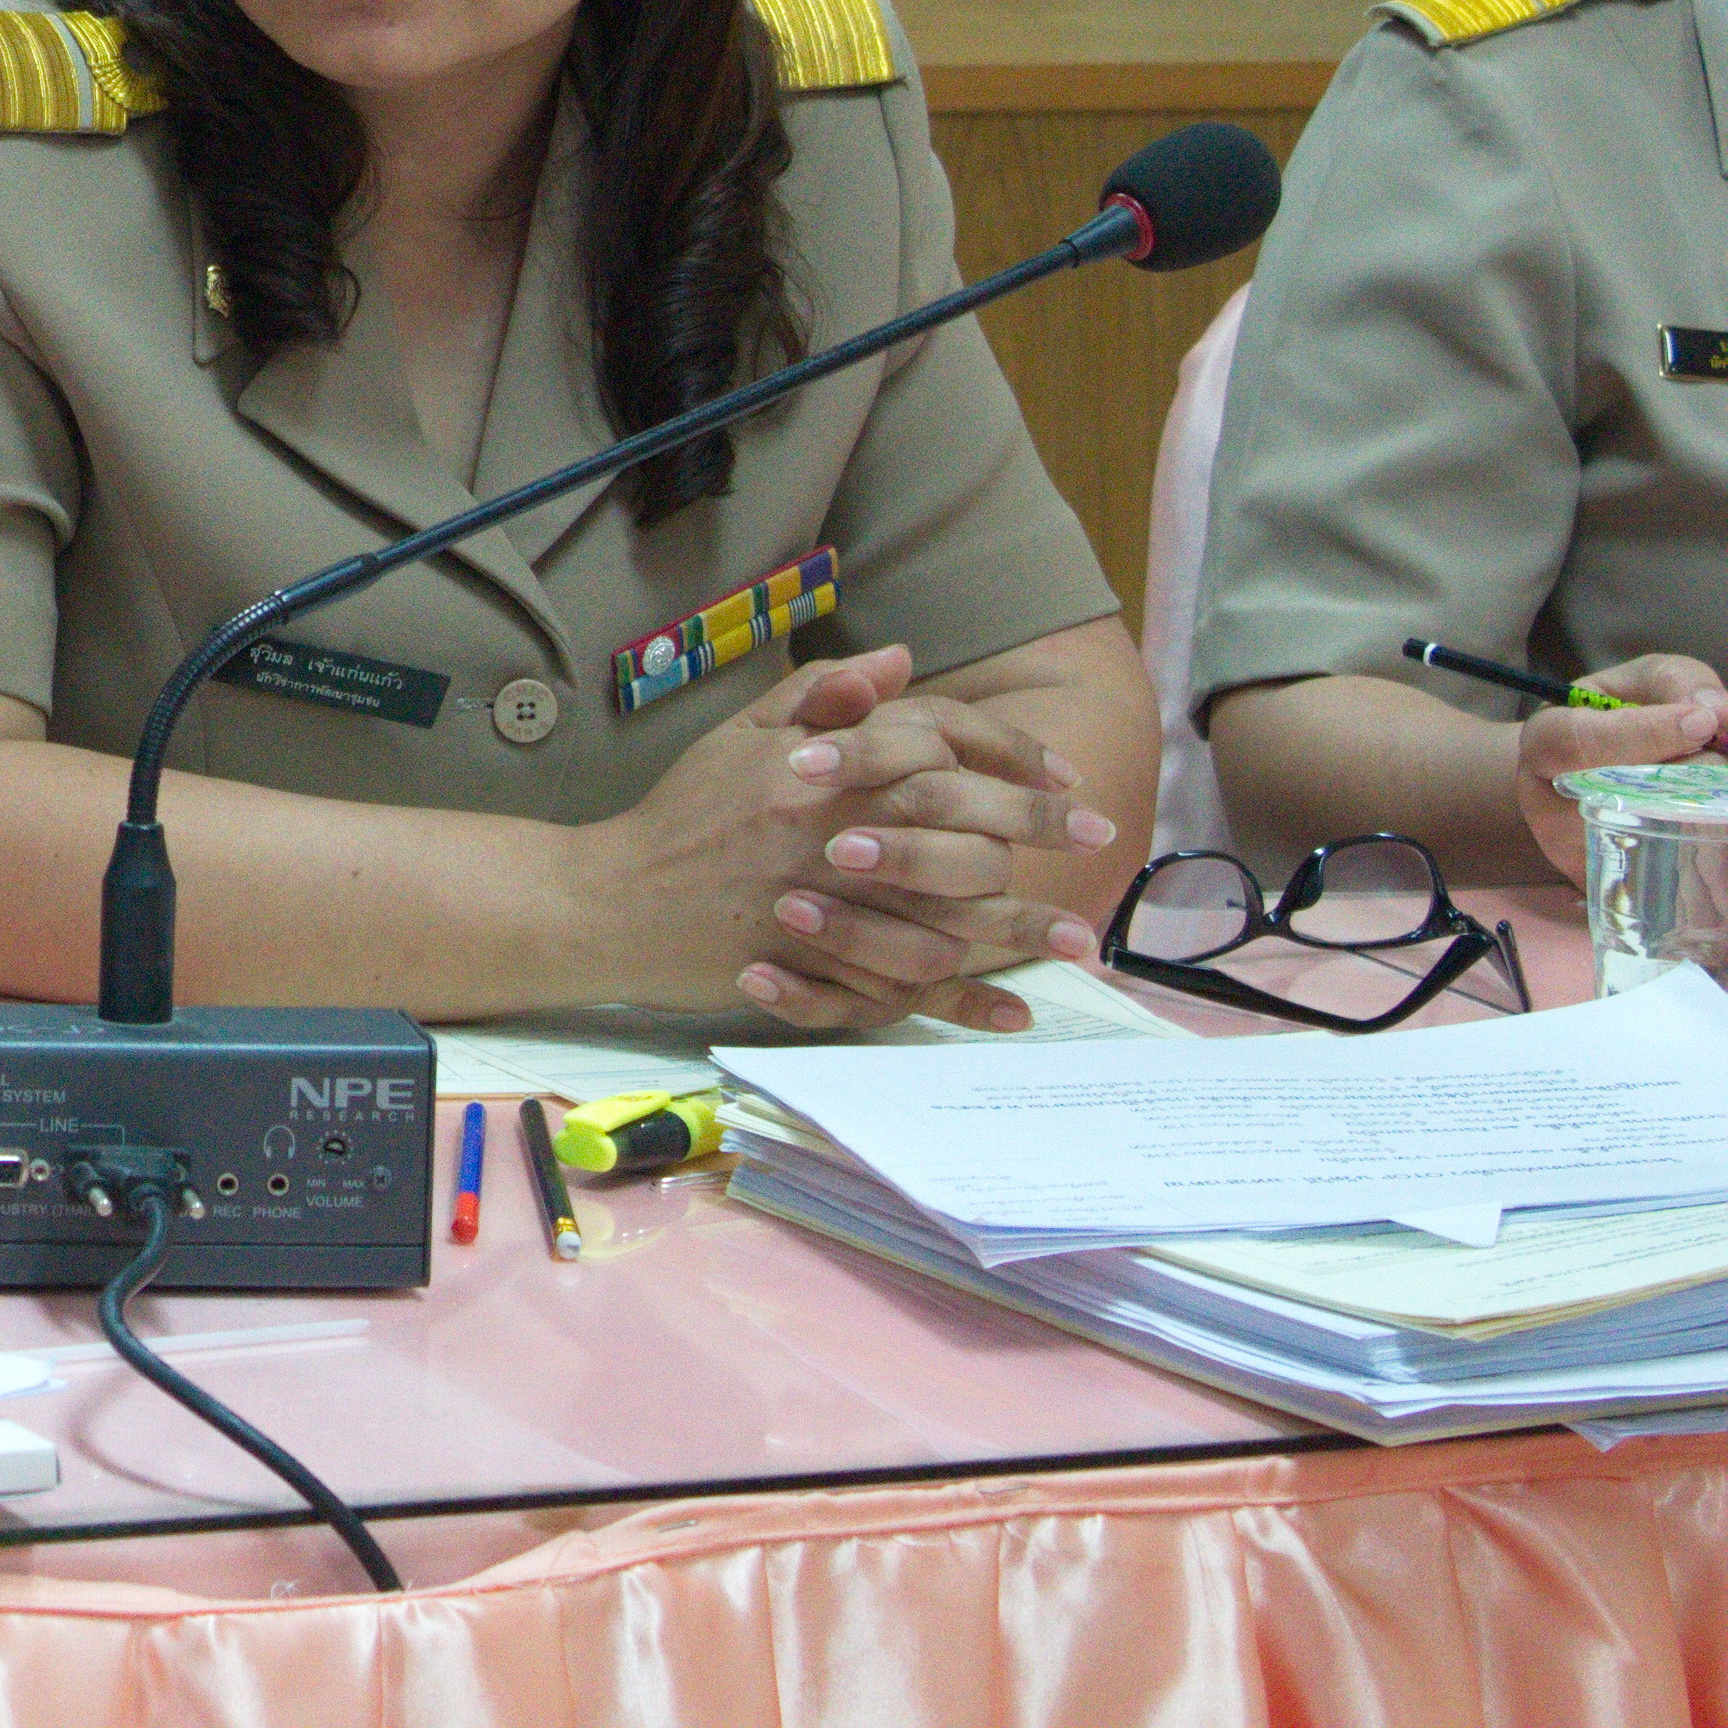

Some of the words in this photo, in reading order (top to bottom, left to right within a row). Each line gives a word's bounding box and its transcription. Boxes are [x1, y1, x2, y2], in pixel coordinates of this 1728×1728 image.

[2, 1090, 67, 1104] SYSTEM
[290, 1076, 415, 1110] NPE
[289, 1110, 415, 1123] RESEARCH
[39, 1117, 80, 1133] LINE
[306, 1178, 326, 1189] MIN
[342, 1178, 366, 1189] MAX
[306, 1194, 364, 1209] VOLUME
[213, 1205, 242, 1218] REC
[252, 1207, 301, 1219] PHONE
